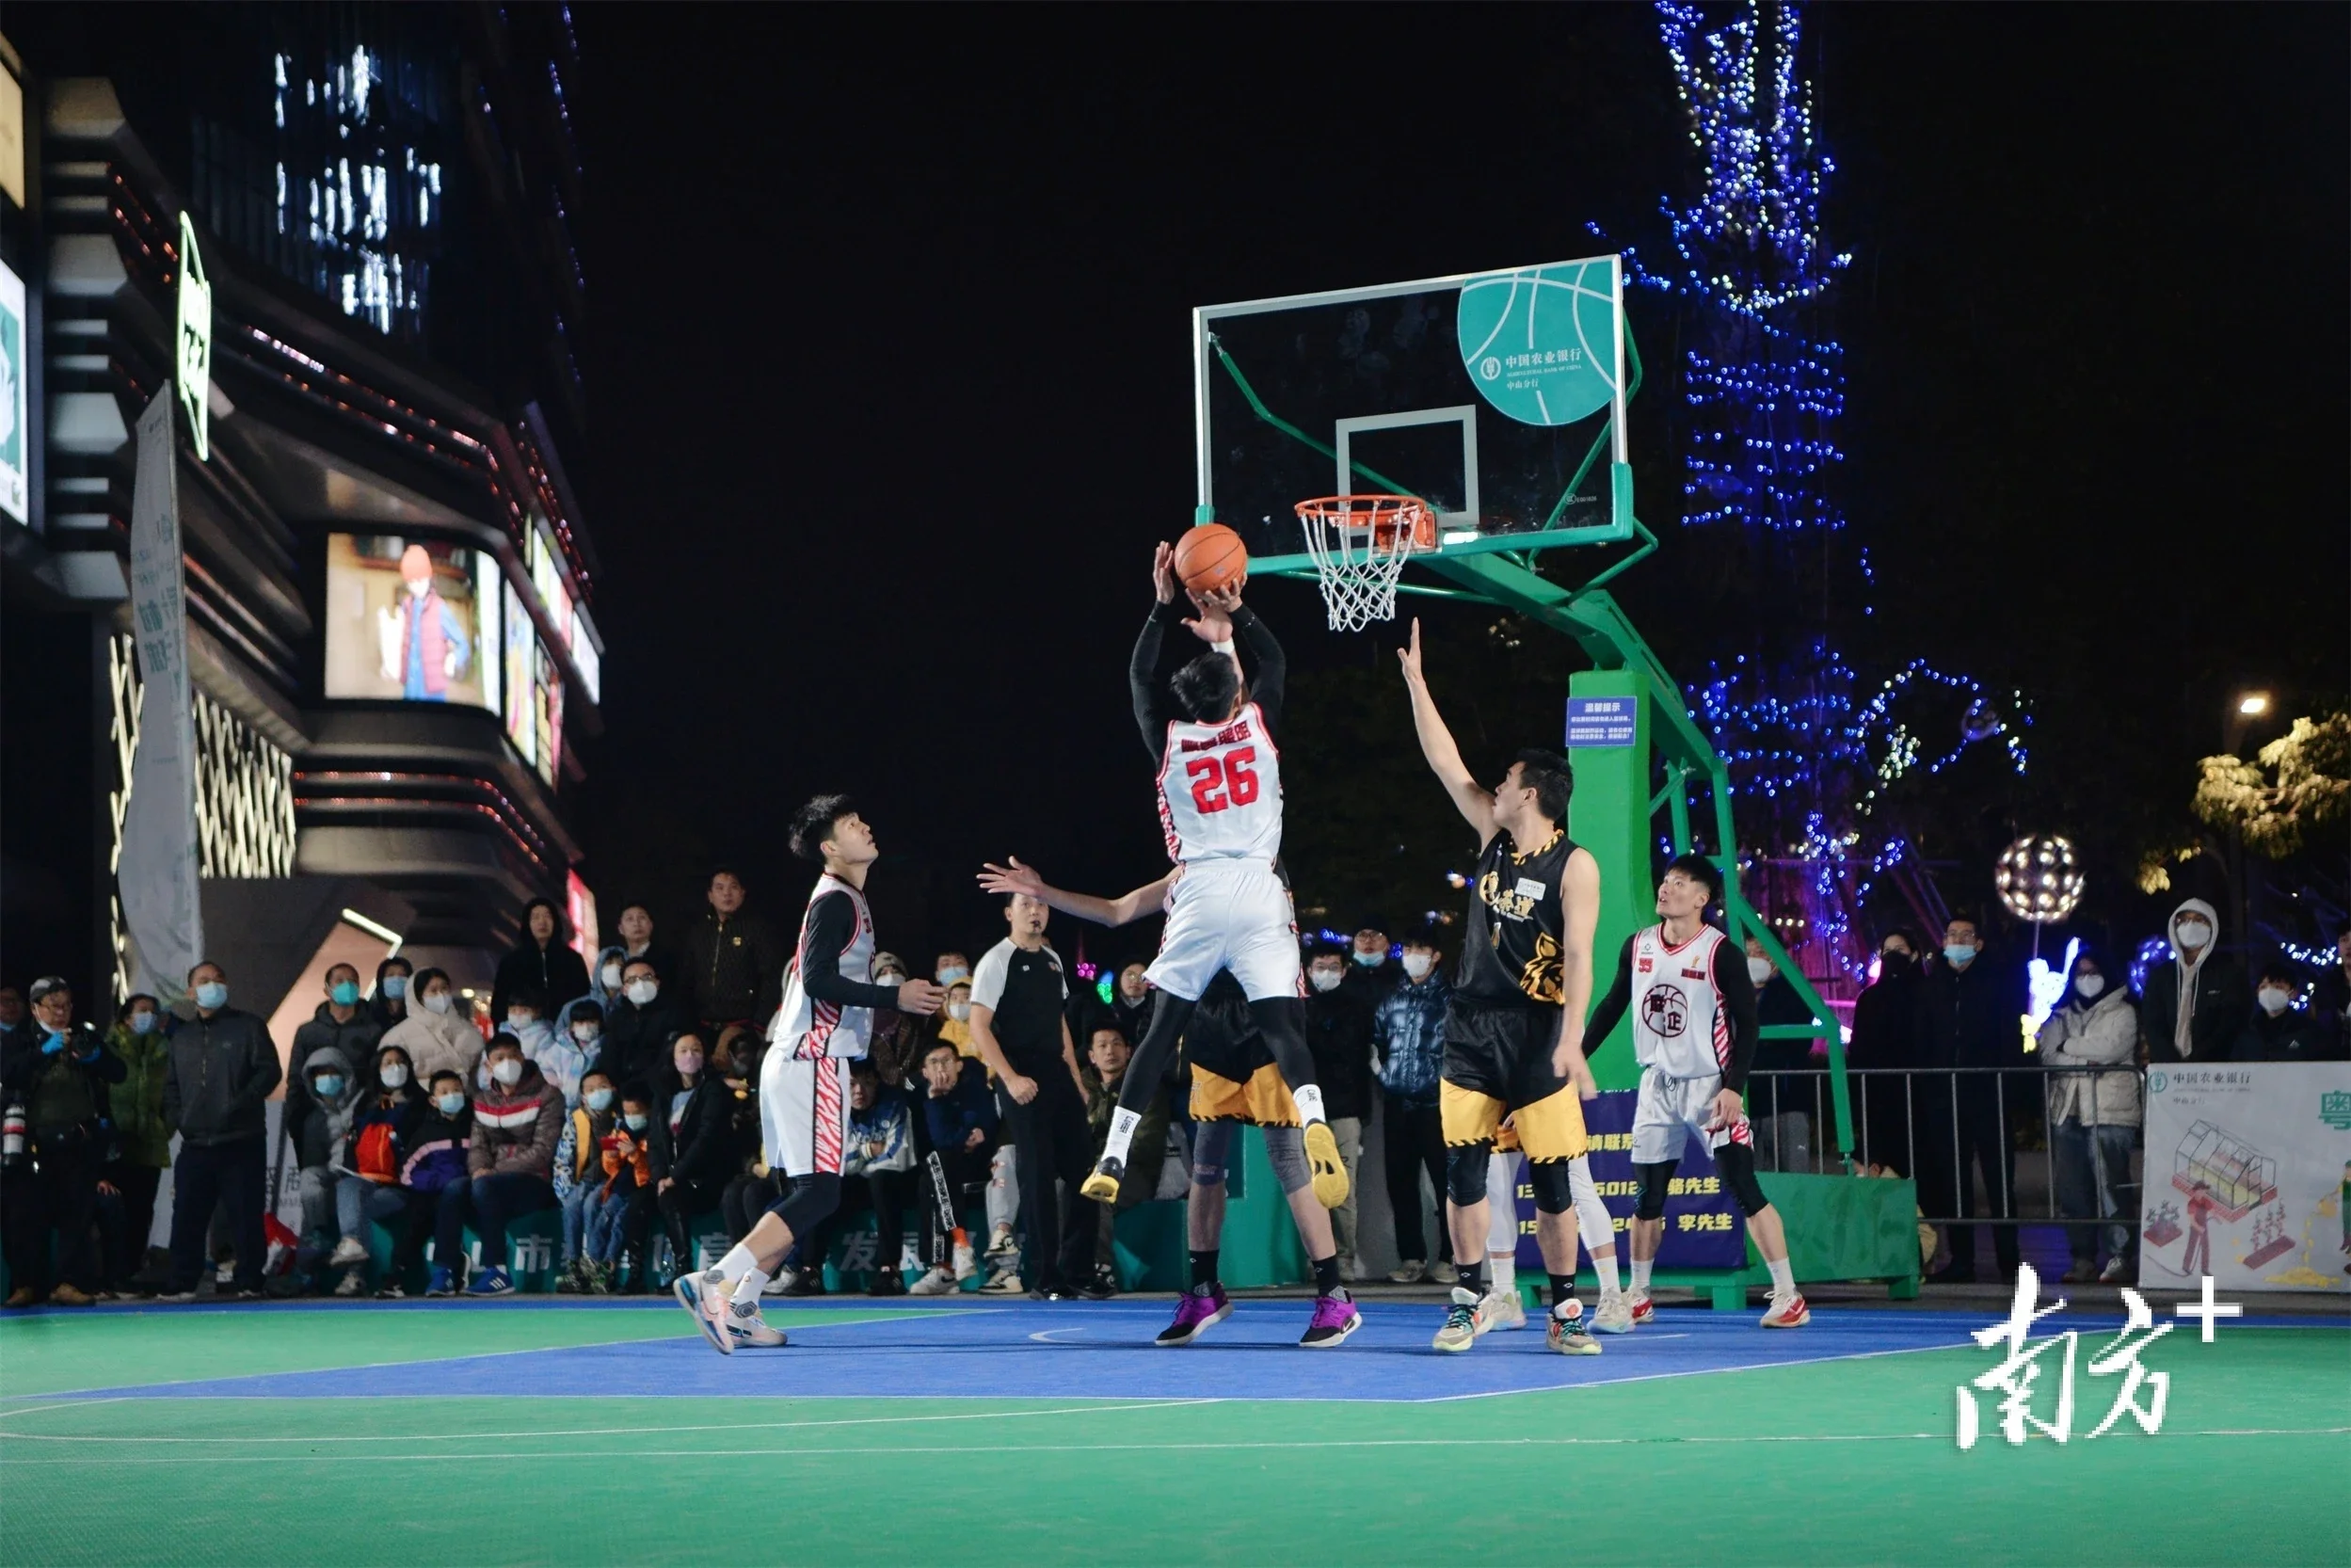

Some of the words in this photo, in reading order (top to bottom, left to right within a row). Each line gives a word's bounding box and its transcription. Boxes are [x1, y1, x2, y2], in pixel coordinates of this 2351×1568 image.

[1506, 347, 1581, 368] 中国农业银行
[1507, 377, 1539, 391] 中山分行
[1185, 745, 1259, 814] 26
[2173, 1071, 2251, 1084] 中国农业银行
[1678, 1213, 1733, 1231] 李先生
